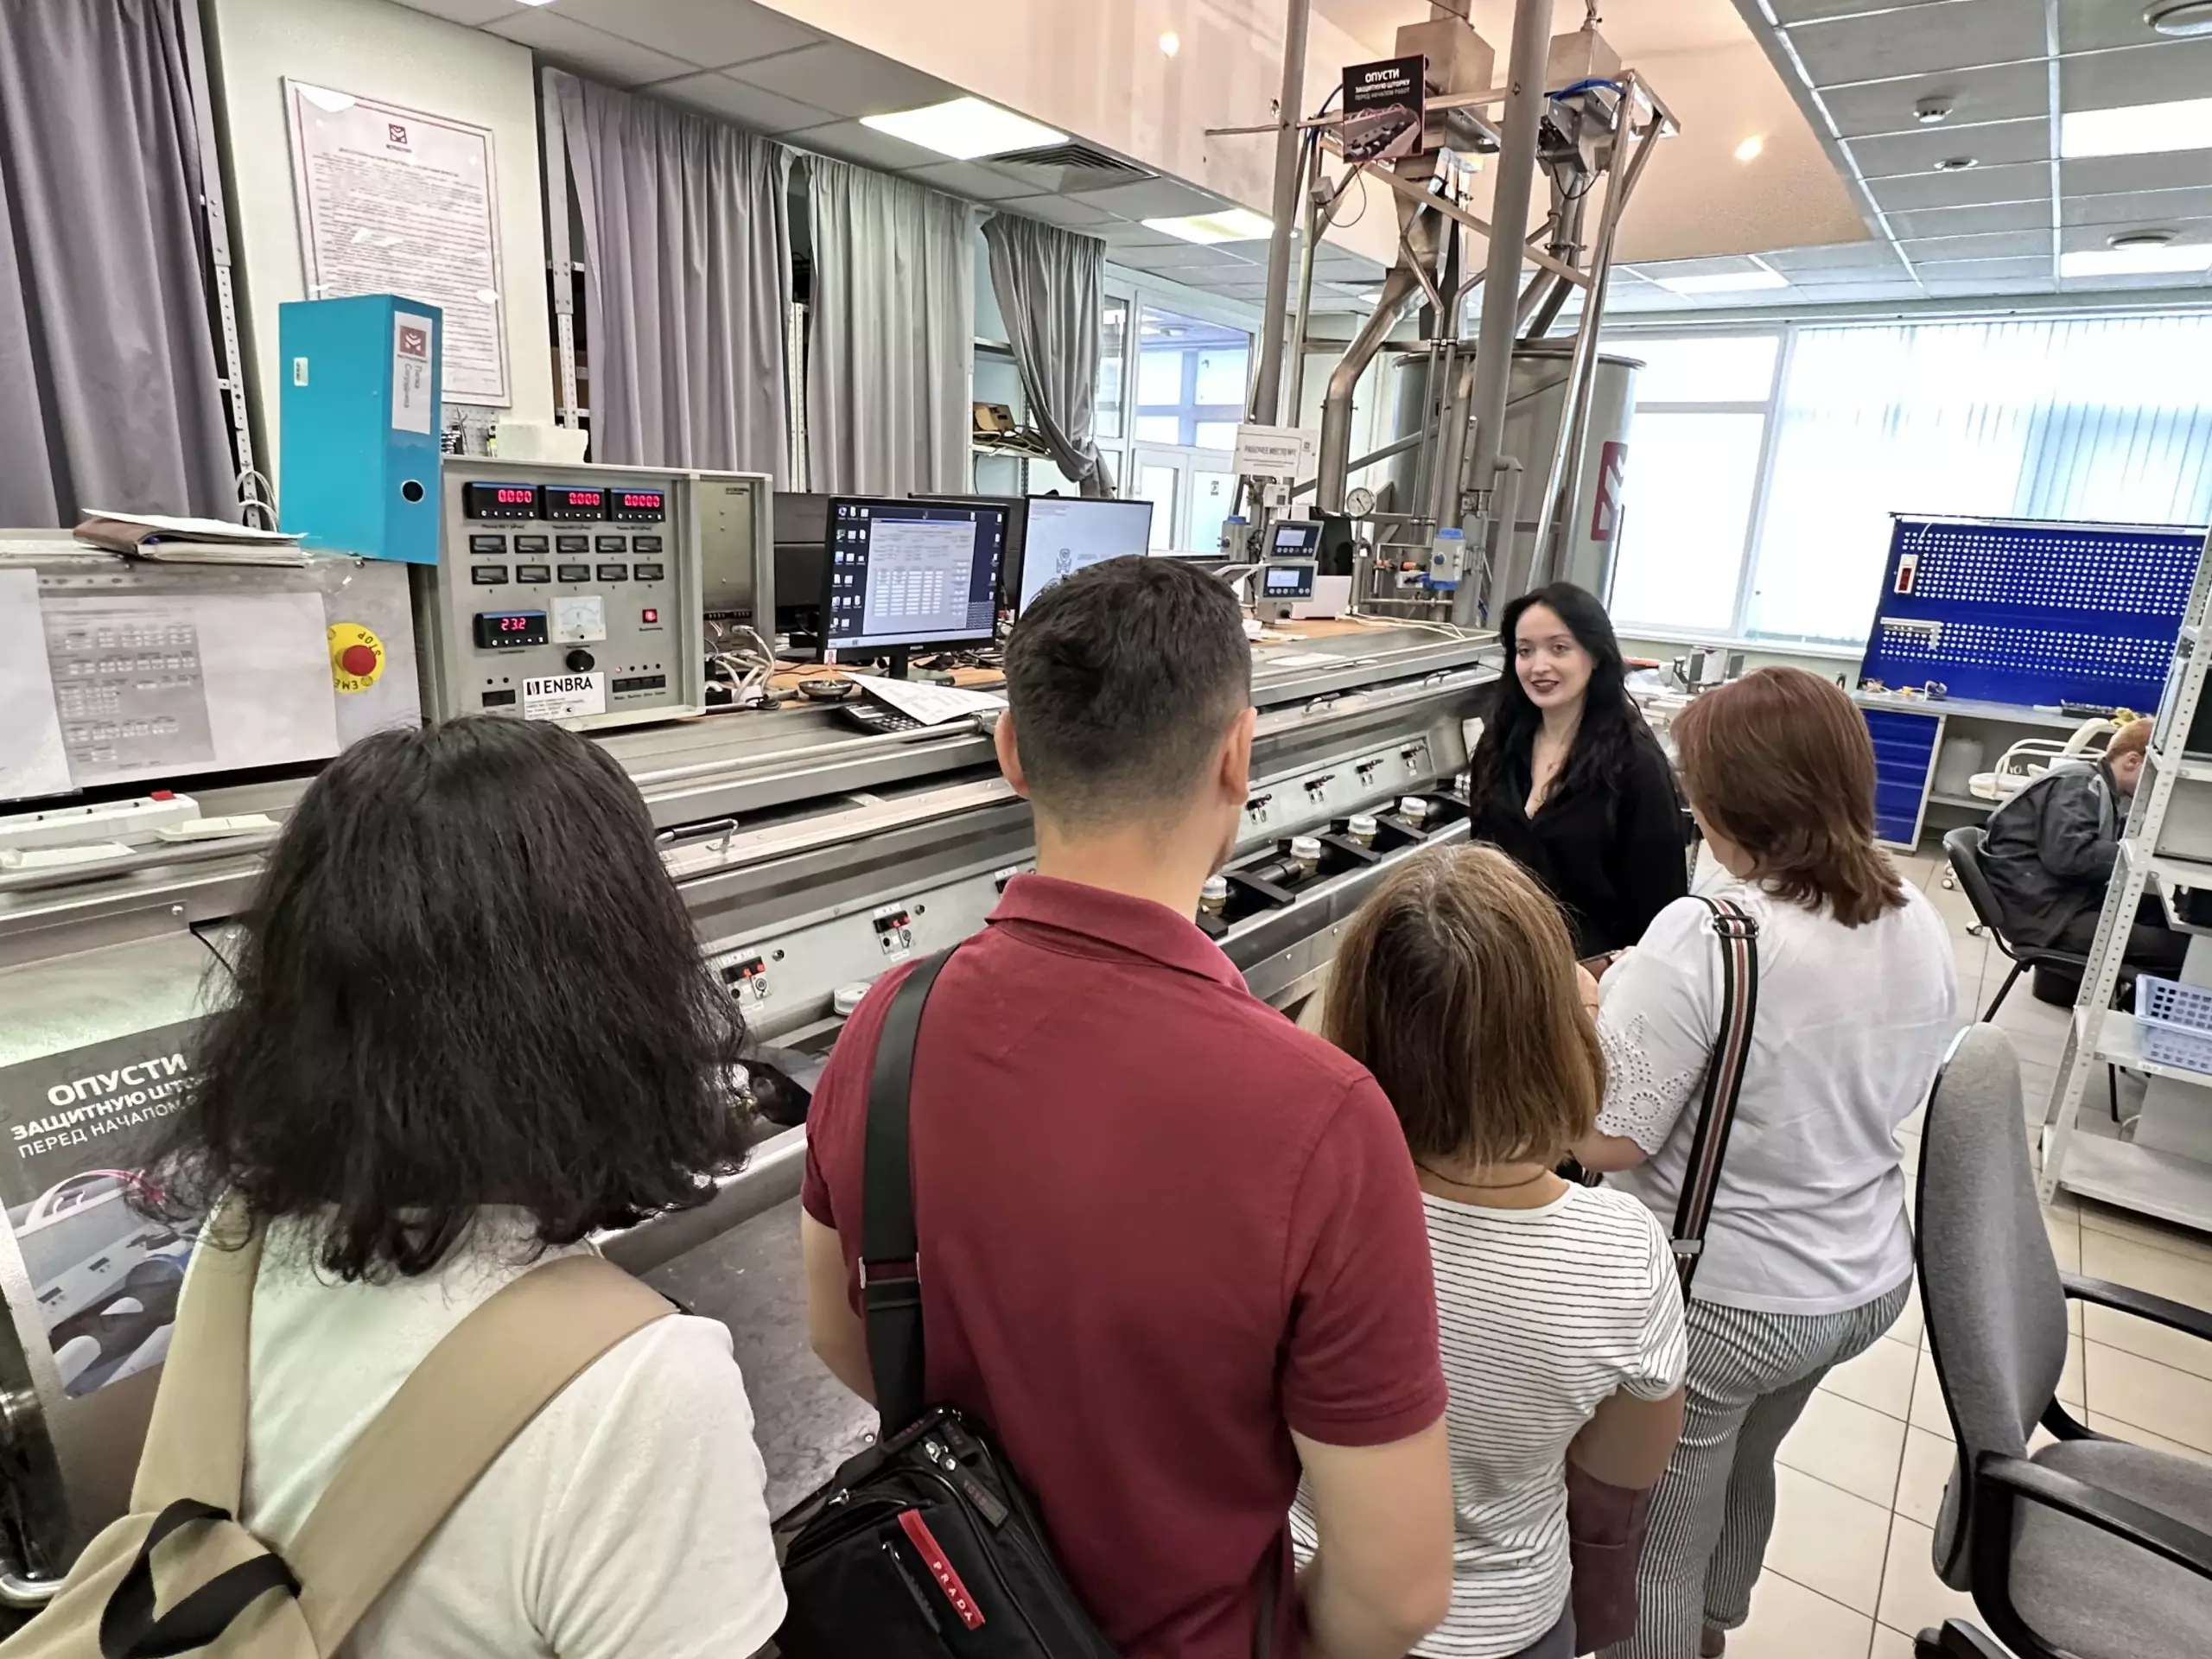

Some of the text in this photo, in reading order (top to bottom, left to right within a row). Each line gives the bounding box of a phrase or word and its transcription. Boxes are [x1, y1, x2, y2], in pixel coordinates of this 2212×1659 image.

[1355, 82, 1387, 93] ЗАЩИТНУЮ
[1365, 68, 1400, 83] ОПУСТИ
[543, 677, 594, 695] ENBRA
[48, 1053, 188, 1106] ОПУСТИ
[10, 1090, 147, 1141] ЗАЩИТНУЮ
[17, 1129, 87, 1159] ПЕРЕД
[932, 1560, 974, 1622] PRADA
